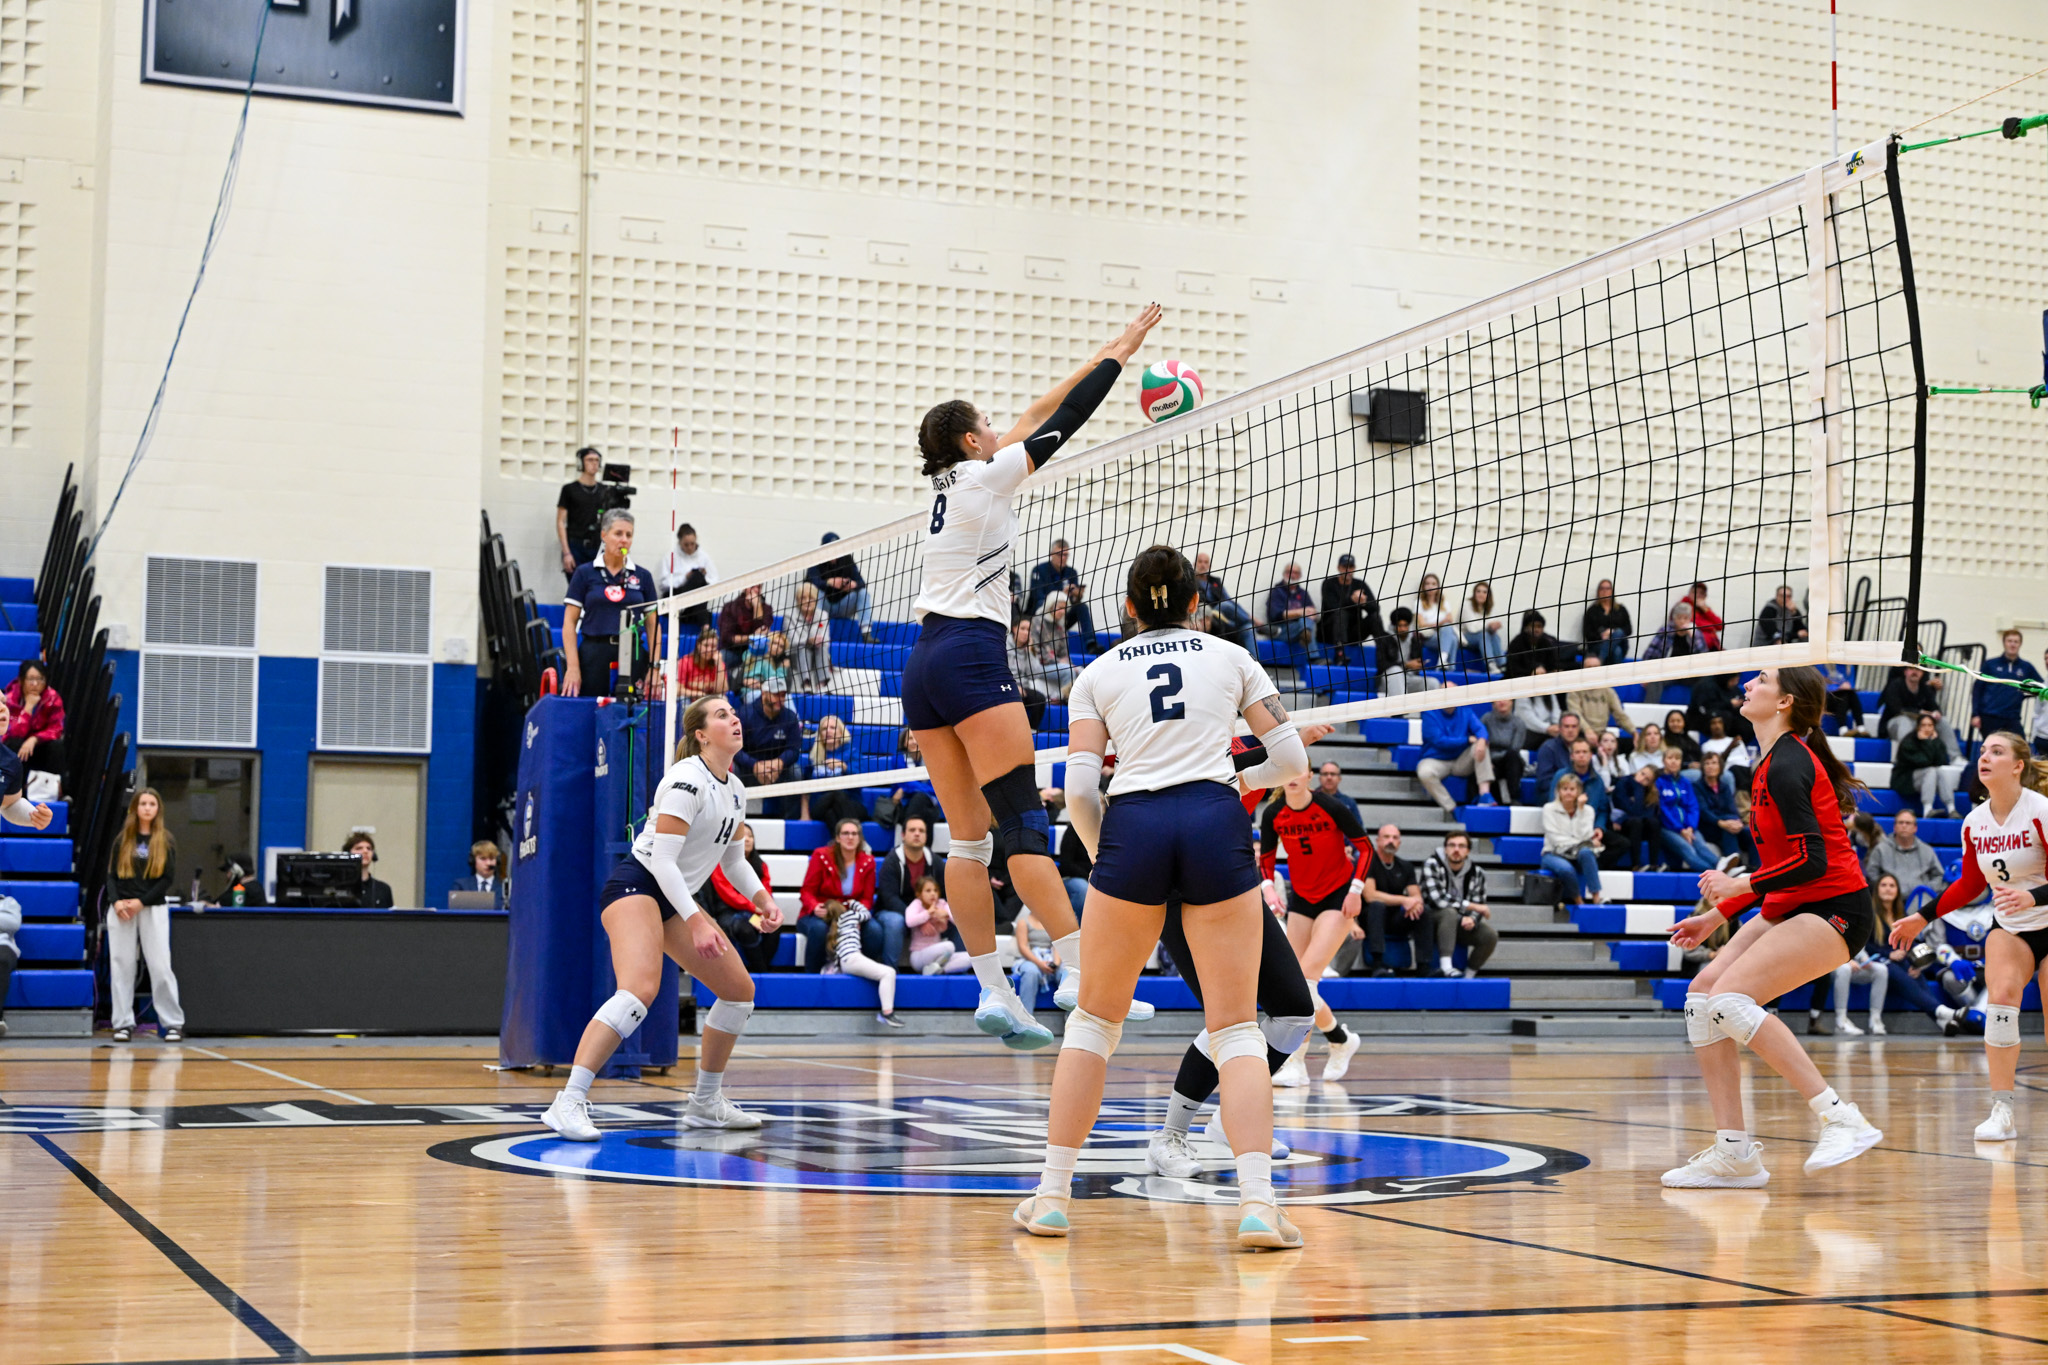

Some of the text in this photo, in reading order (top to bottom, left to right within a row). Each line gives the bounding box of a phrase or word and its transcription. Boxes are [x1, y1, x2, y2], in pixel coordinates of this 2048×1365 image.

[1151, 399, 1180, 413] molten
[929, 492, 948, 535] 8
[1118, 637, 1204, 662] KNIGHTS
[1146, 662, 1186, 724] 2
[714, 817, 734, 845] 14
[1299, 837, 1313, 855] 5
[1991, 858, 2011, 883] 3
